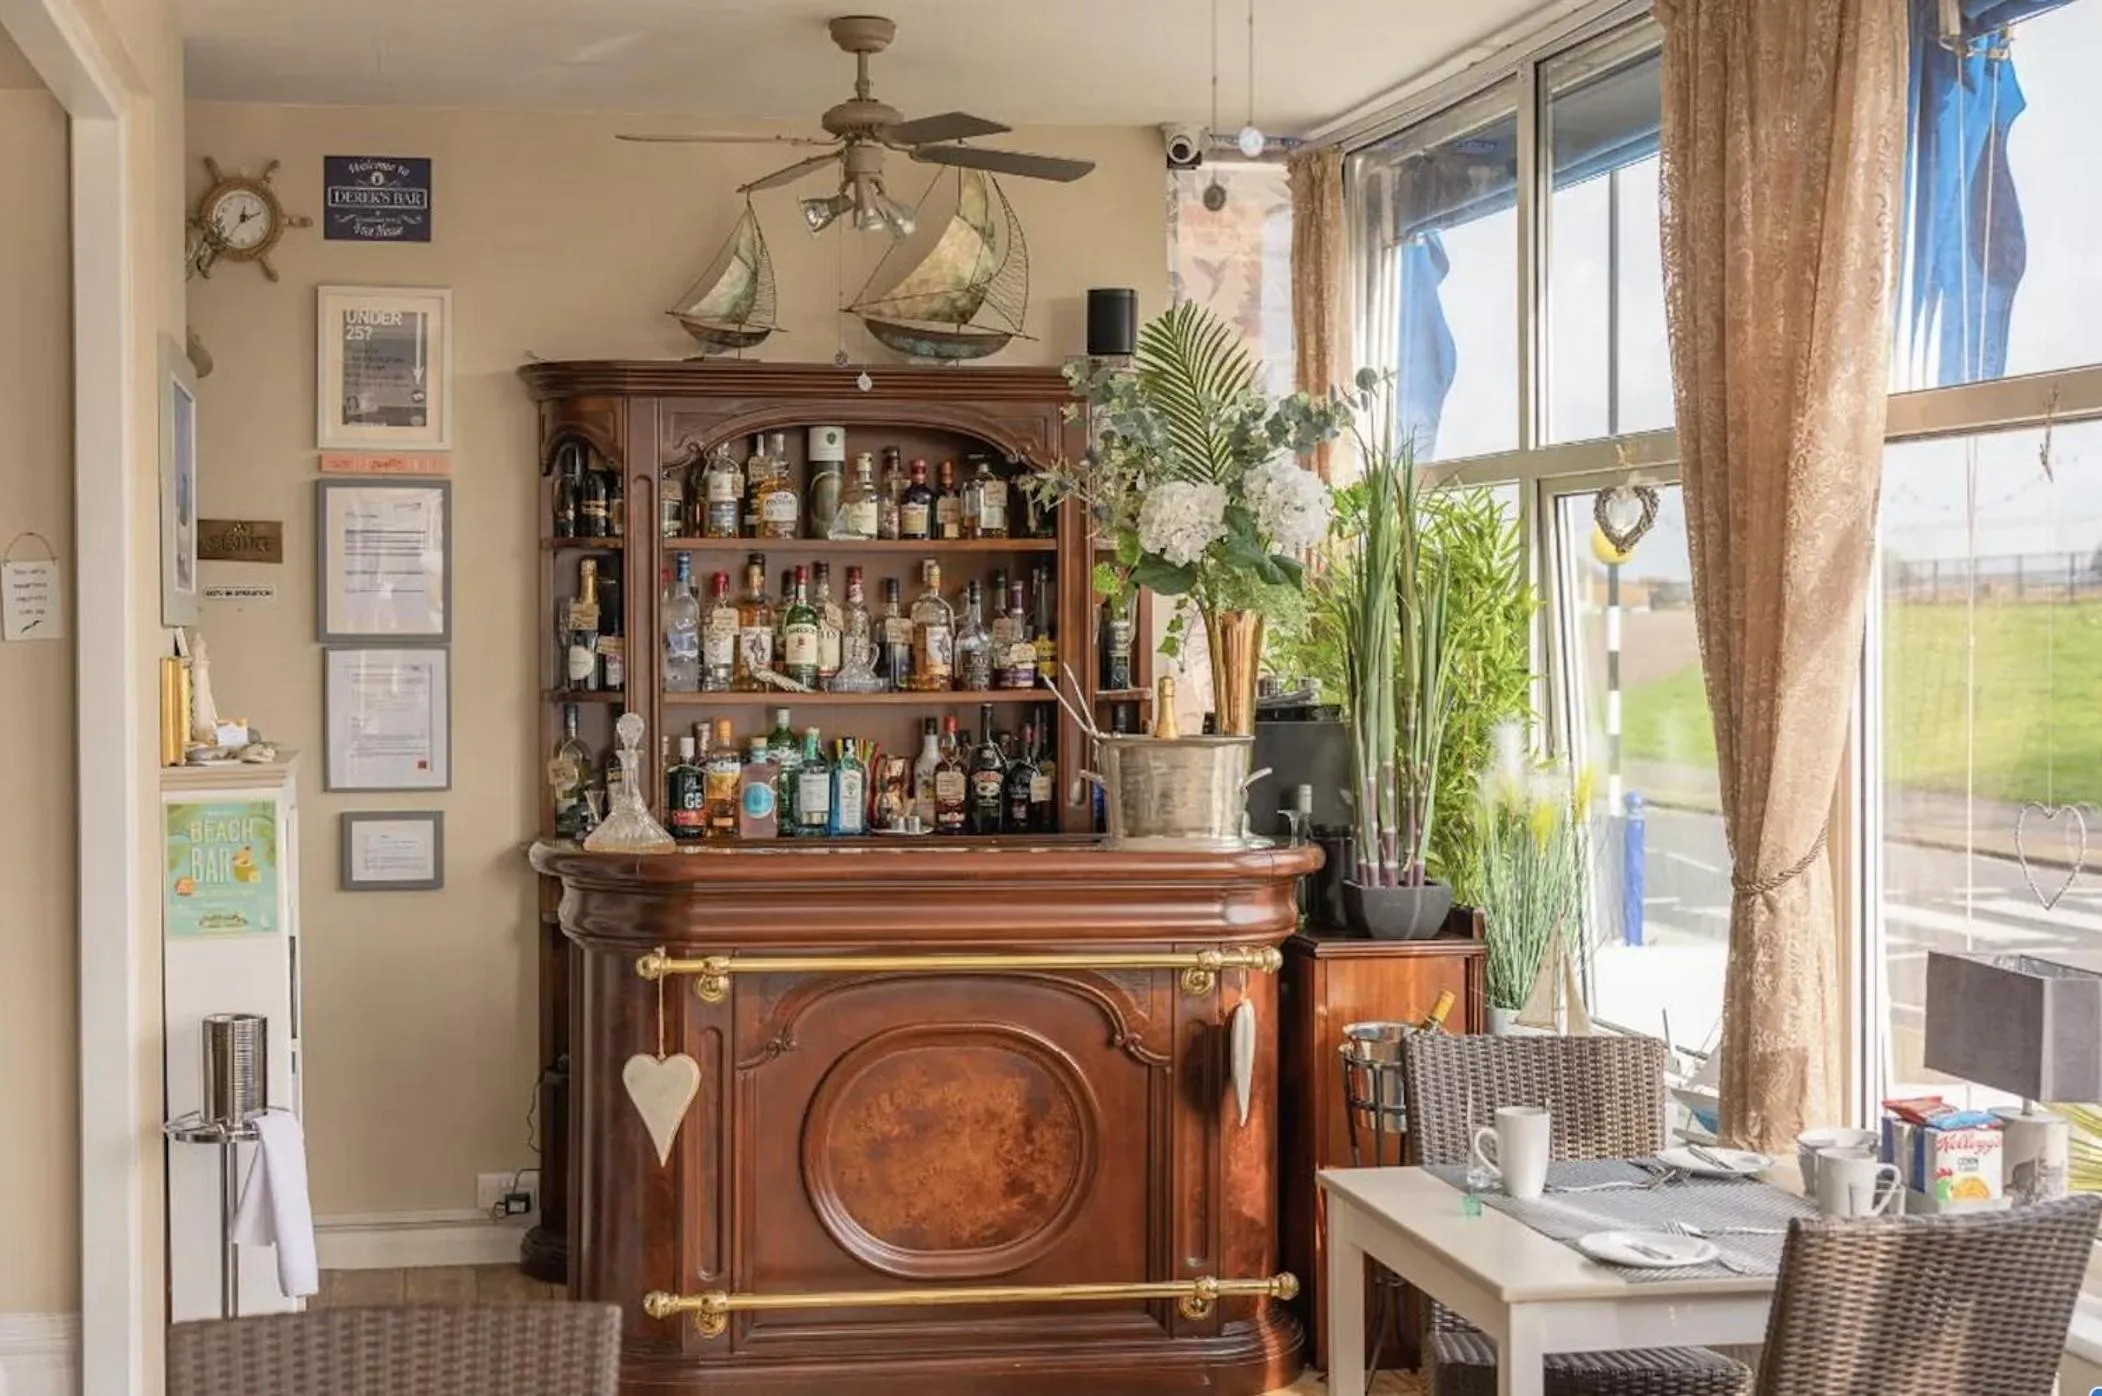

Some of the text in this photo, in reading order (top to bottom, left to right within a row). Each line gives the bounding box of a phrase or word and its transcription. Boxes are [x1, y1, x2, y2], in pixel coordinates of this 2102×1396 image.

[348, 160, 396, 174] Welcome
[393, 191, 422, 205] BAR
[345, 308, 403, 326] UNDER
[346, 326, 373, 341] 25?
[684, 792, 704, 809] GB
[190, 819, 254, 844] BEACH
[191, 848, 233, 883] BAR
[1935, 1133, 2004, 1156] Kellogg's
